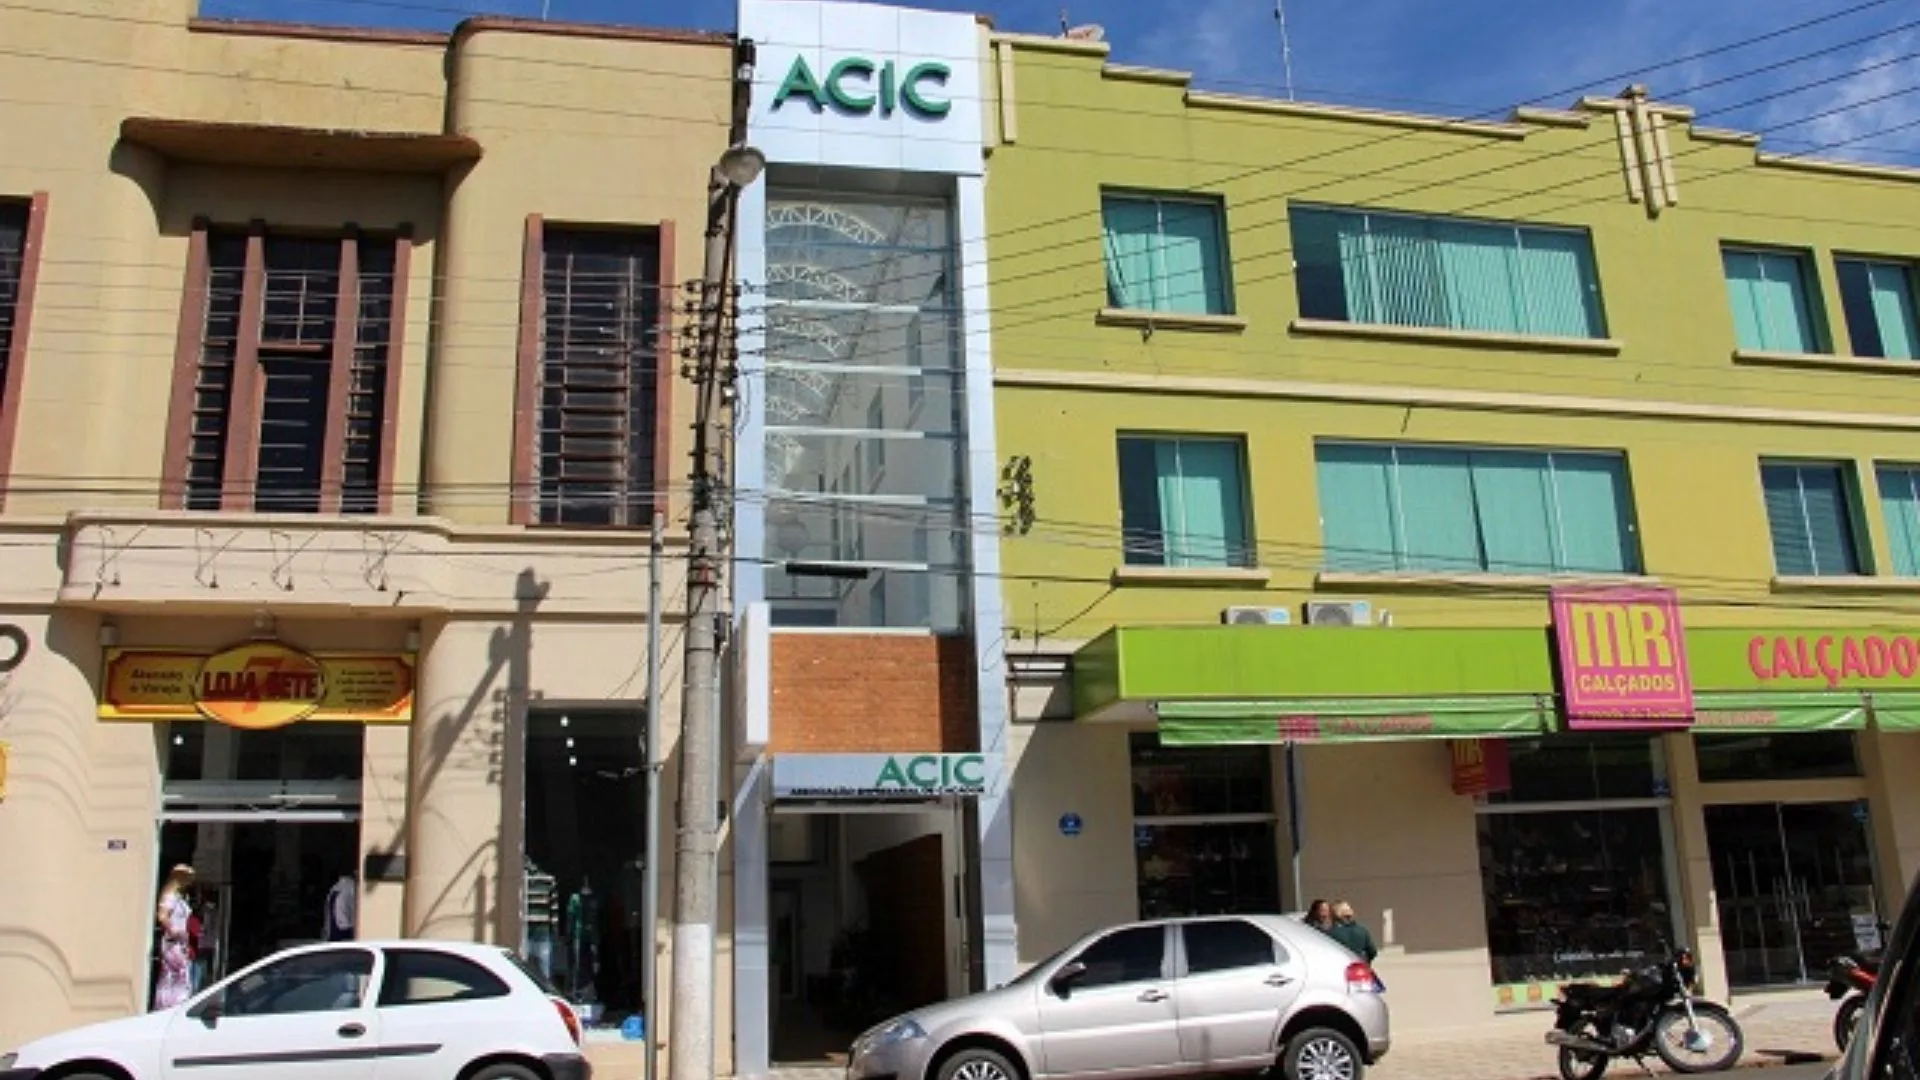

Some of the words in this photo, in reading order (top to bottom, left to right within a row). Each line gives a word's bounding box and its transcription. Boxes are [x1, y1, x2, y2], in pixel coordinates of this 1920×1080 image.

[771, 54, 952, 119] ACIC
[1571, 603, 1673, 667] MR
[1748, 635, 1920, 688] CALÇADO
[203, 671, 258, 699] LOJA
[1579, 674, 1675, 696] CALÇADOS
[875, 755, 985, 787] ACIC
